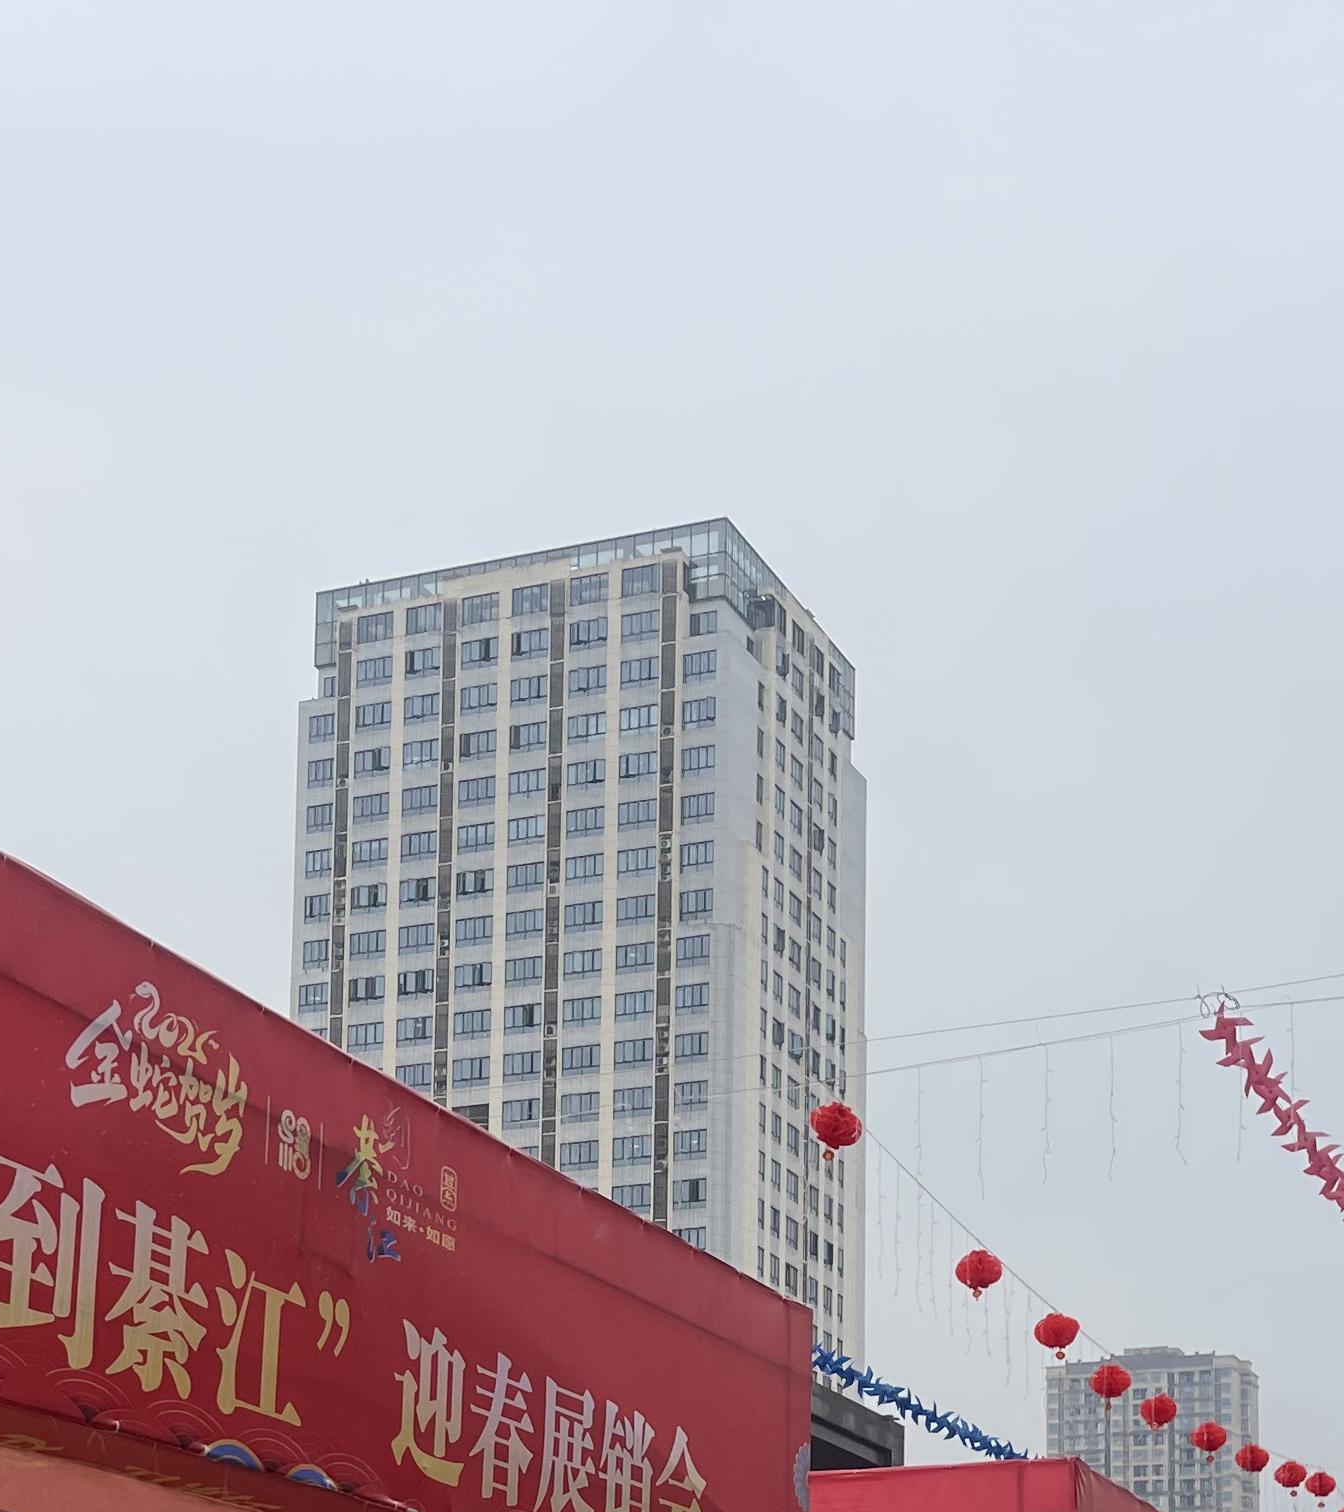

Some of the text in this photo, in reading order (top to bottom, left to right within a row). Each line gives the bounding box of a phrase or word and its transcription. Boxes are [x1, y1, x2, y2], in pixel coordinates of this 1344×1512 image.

[65, 999, 248, 1176] 金蛇贺岁
[387, 1170, 424, 1197] DAO
[386, 1189, 456, 1232] QIJIANG
